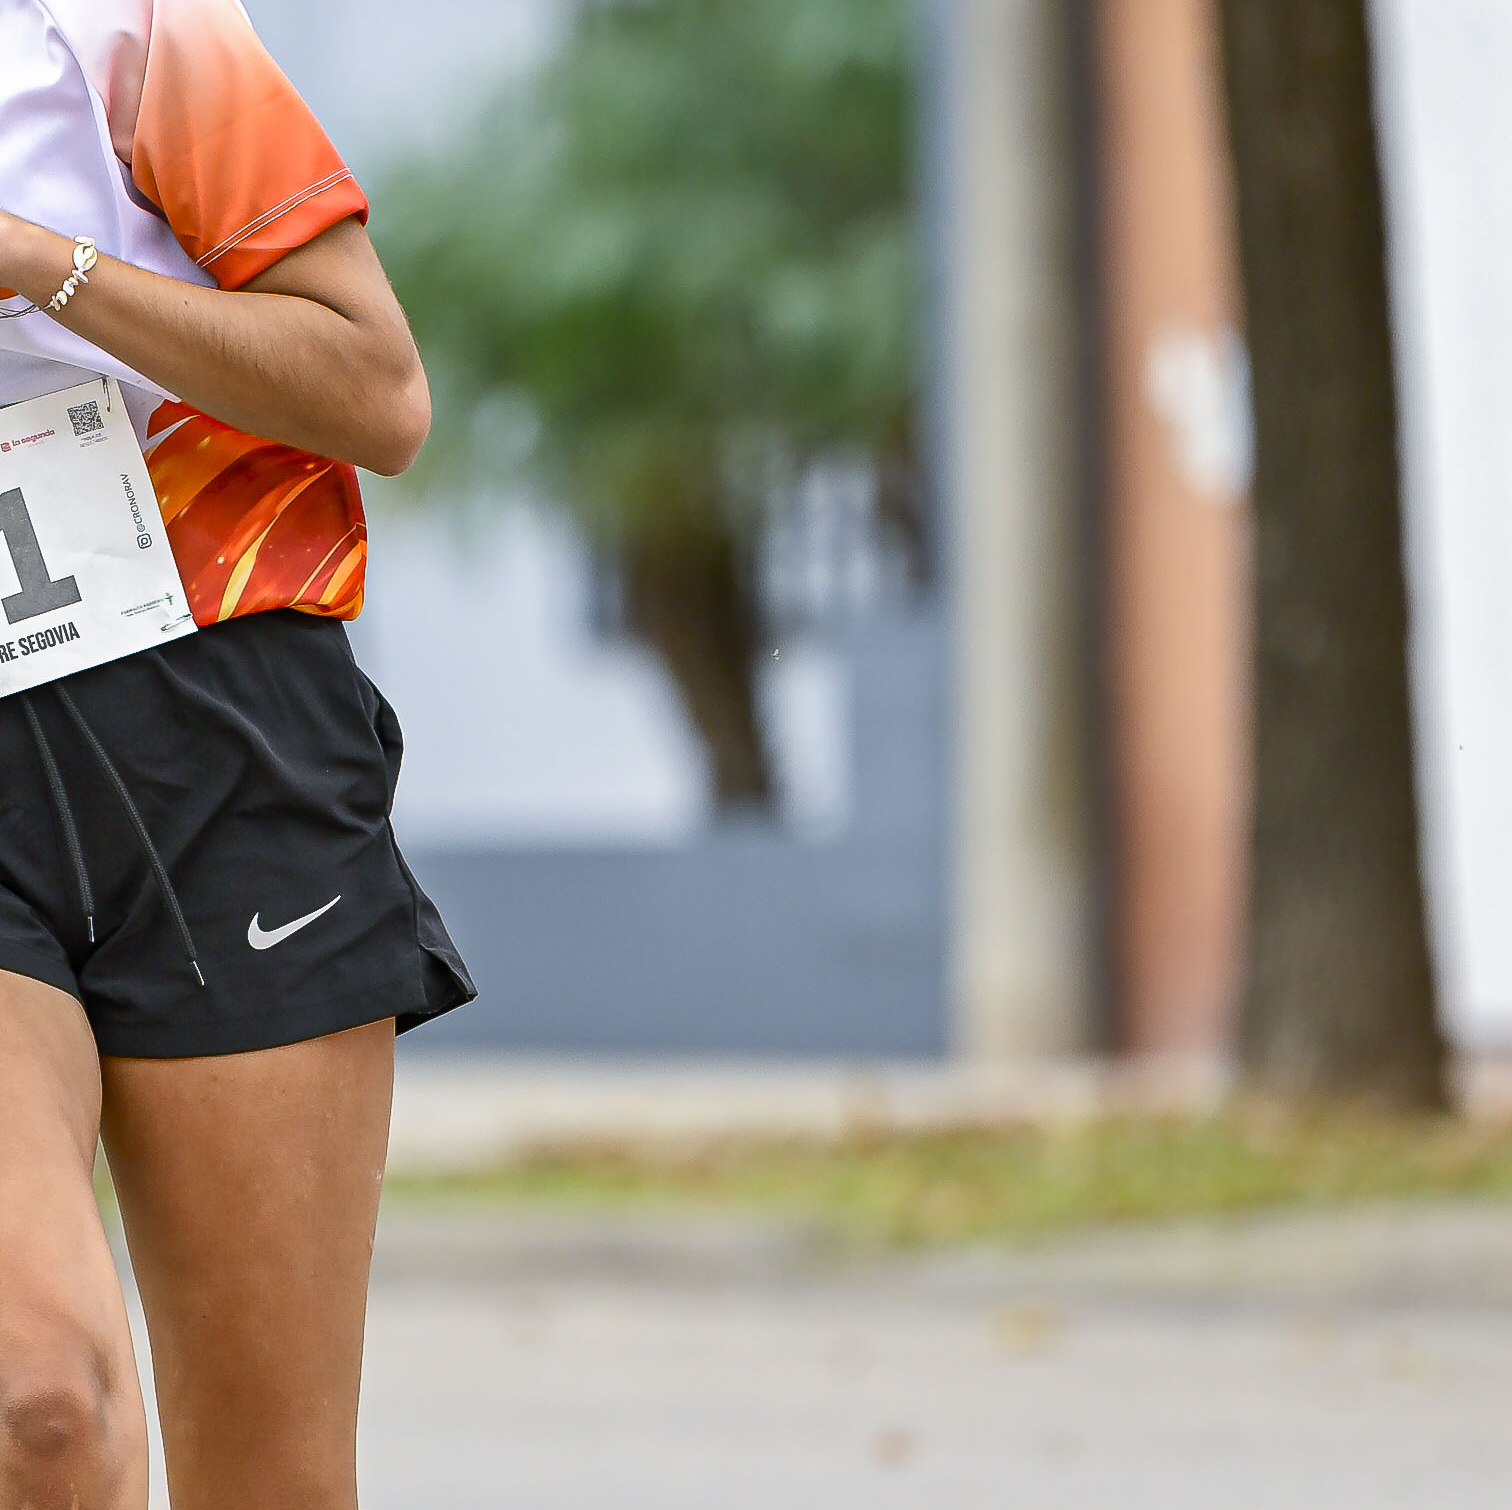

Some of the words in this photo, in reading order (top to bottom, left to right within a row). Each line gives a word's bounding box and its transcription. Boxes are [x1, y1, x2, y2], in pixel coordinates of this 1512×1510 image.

[11, 439, 21, 447] la
[21, 429, 56, 443] segunda
[119, 473, 146, 533] @CRONORAV
[18, 621, 81, 656] SEGOVIA
